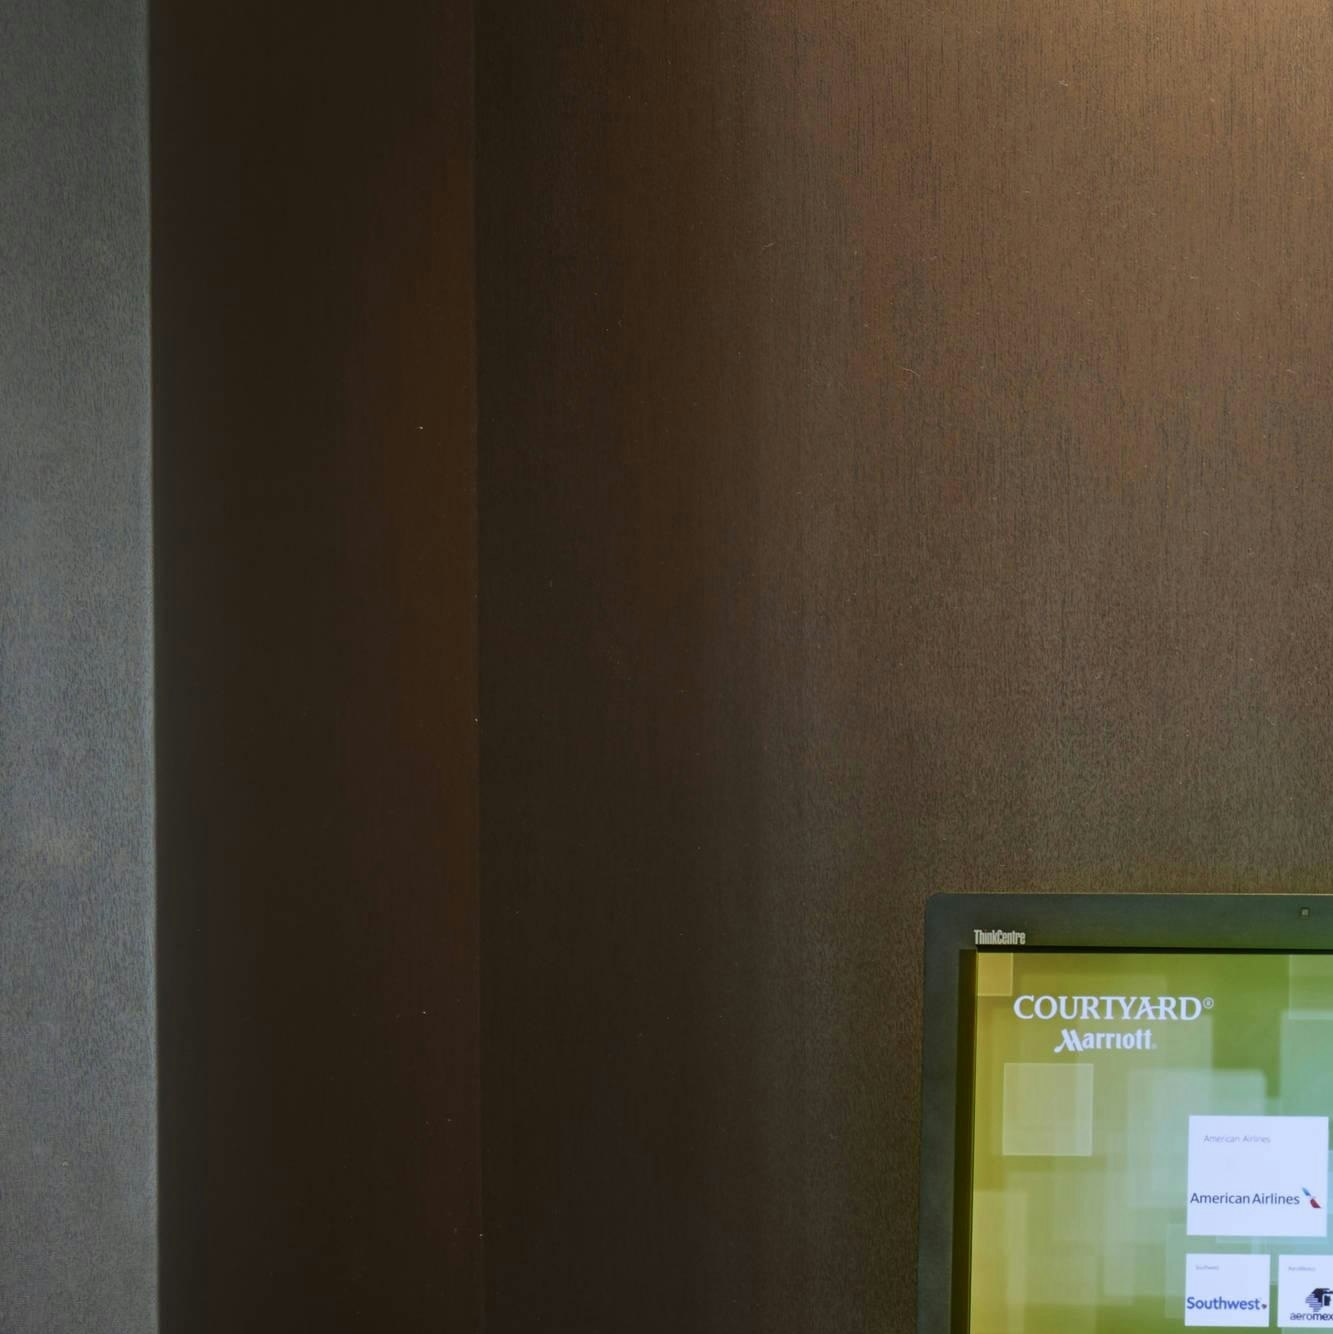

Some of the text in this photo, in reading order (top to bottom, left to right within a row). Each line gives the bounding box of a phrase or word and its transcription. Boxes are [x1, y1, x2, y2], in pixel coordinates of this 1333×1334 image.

[974, 929, 1026, 945] ThinkCentre
[1054, 1028, 1153, 1053] Marriott
[1204, 1135, 1240, 1143] American
[1190, 1192, 1300, 1205] American Airlines
[1186, 1296, 1261, 1310] Southwest
